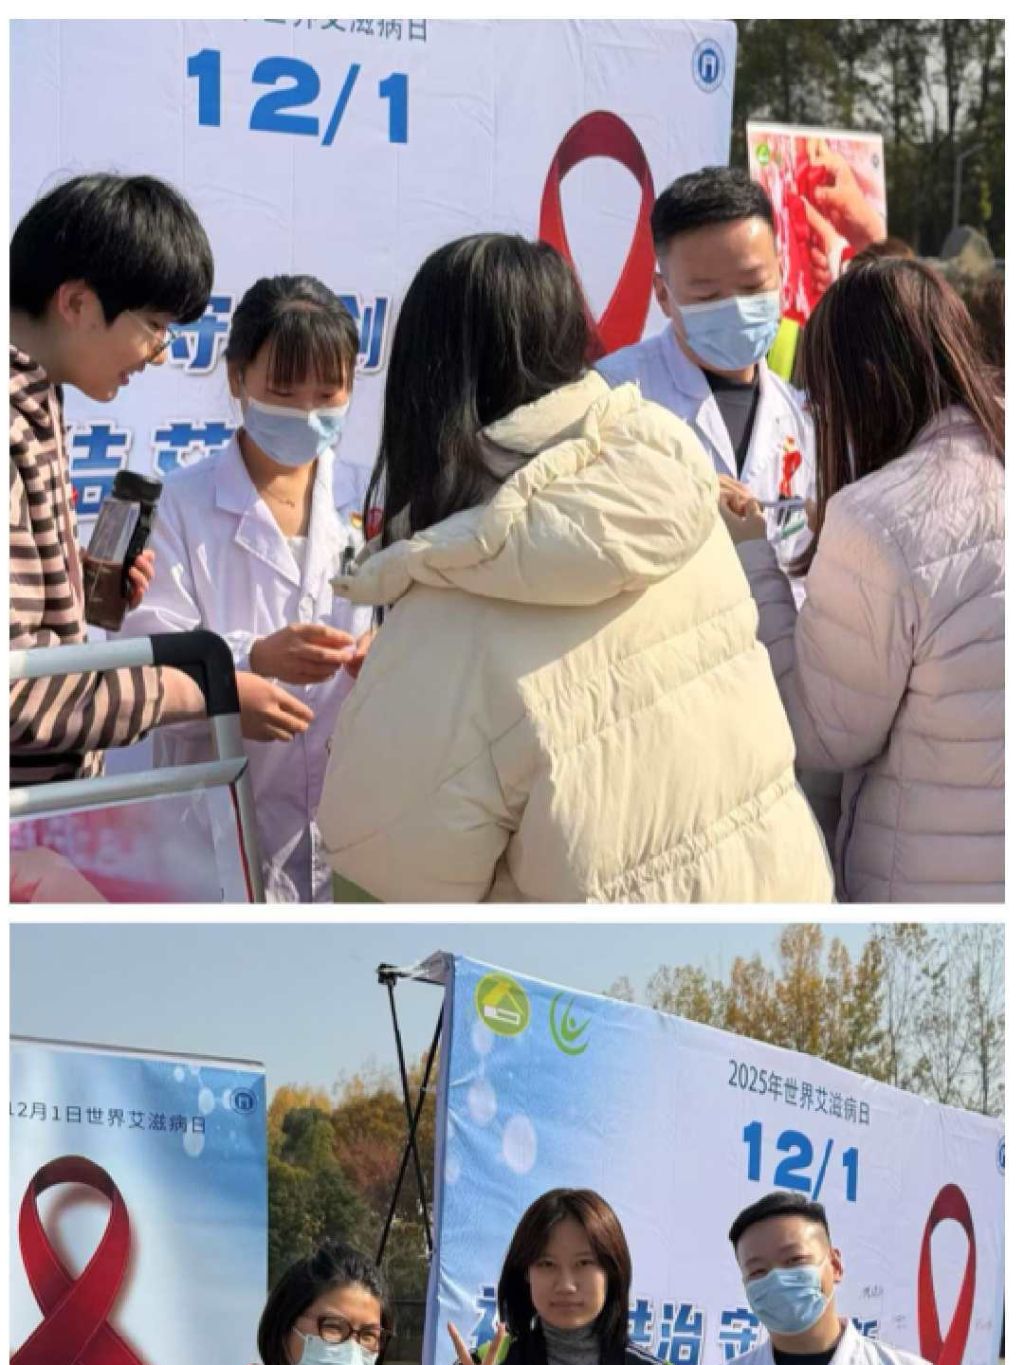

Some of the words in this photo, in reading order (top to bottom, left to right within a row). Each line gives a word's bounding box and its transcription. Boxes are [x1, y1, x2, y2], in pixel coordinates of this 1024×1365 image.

[187, 48, 409, 146] 12/1
[728, 1060, 870, 1126] 2025年世界艾滋病日
[743, 1120, 859, 1202] 12/1
